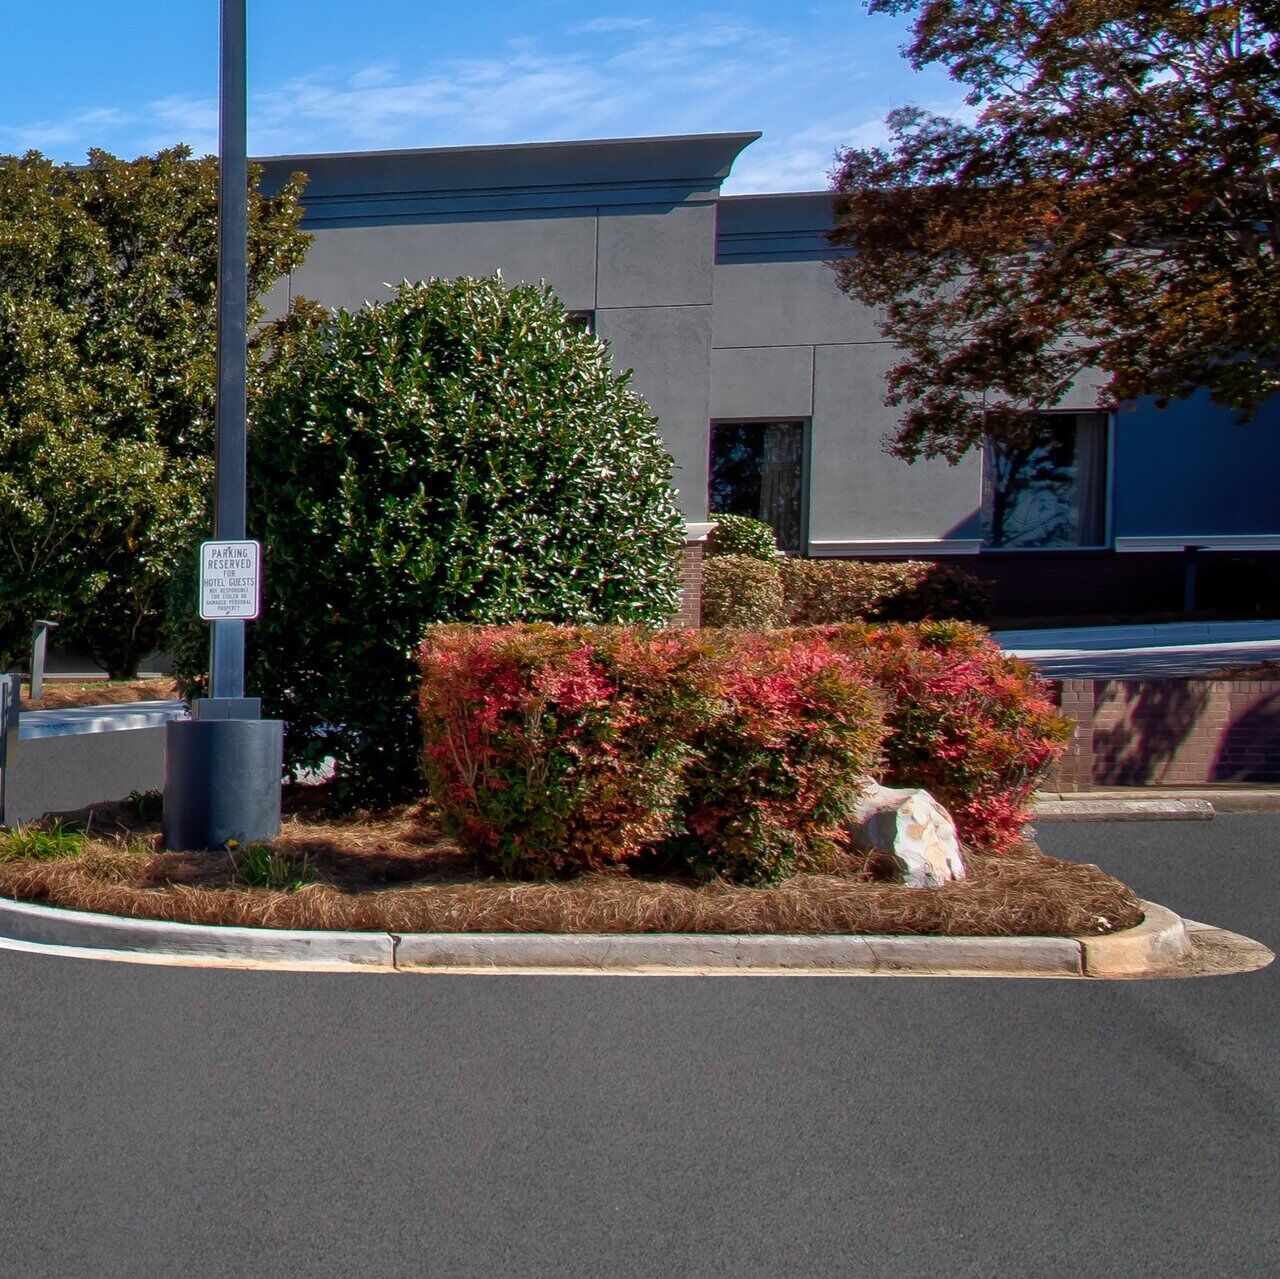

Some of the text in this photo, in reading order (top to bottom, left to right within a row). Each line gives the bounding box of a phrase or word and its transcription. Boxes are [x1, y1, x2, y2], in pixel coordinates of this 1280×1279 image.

[212, 549, 248, 558] PARKING
[208, 559, 251, 569] RESERVED
[223, 570, 236, 578] FOR
[204, 578, 254, 588] HOTEL GUESTS
